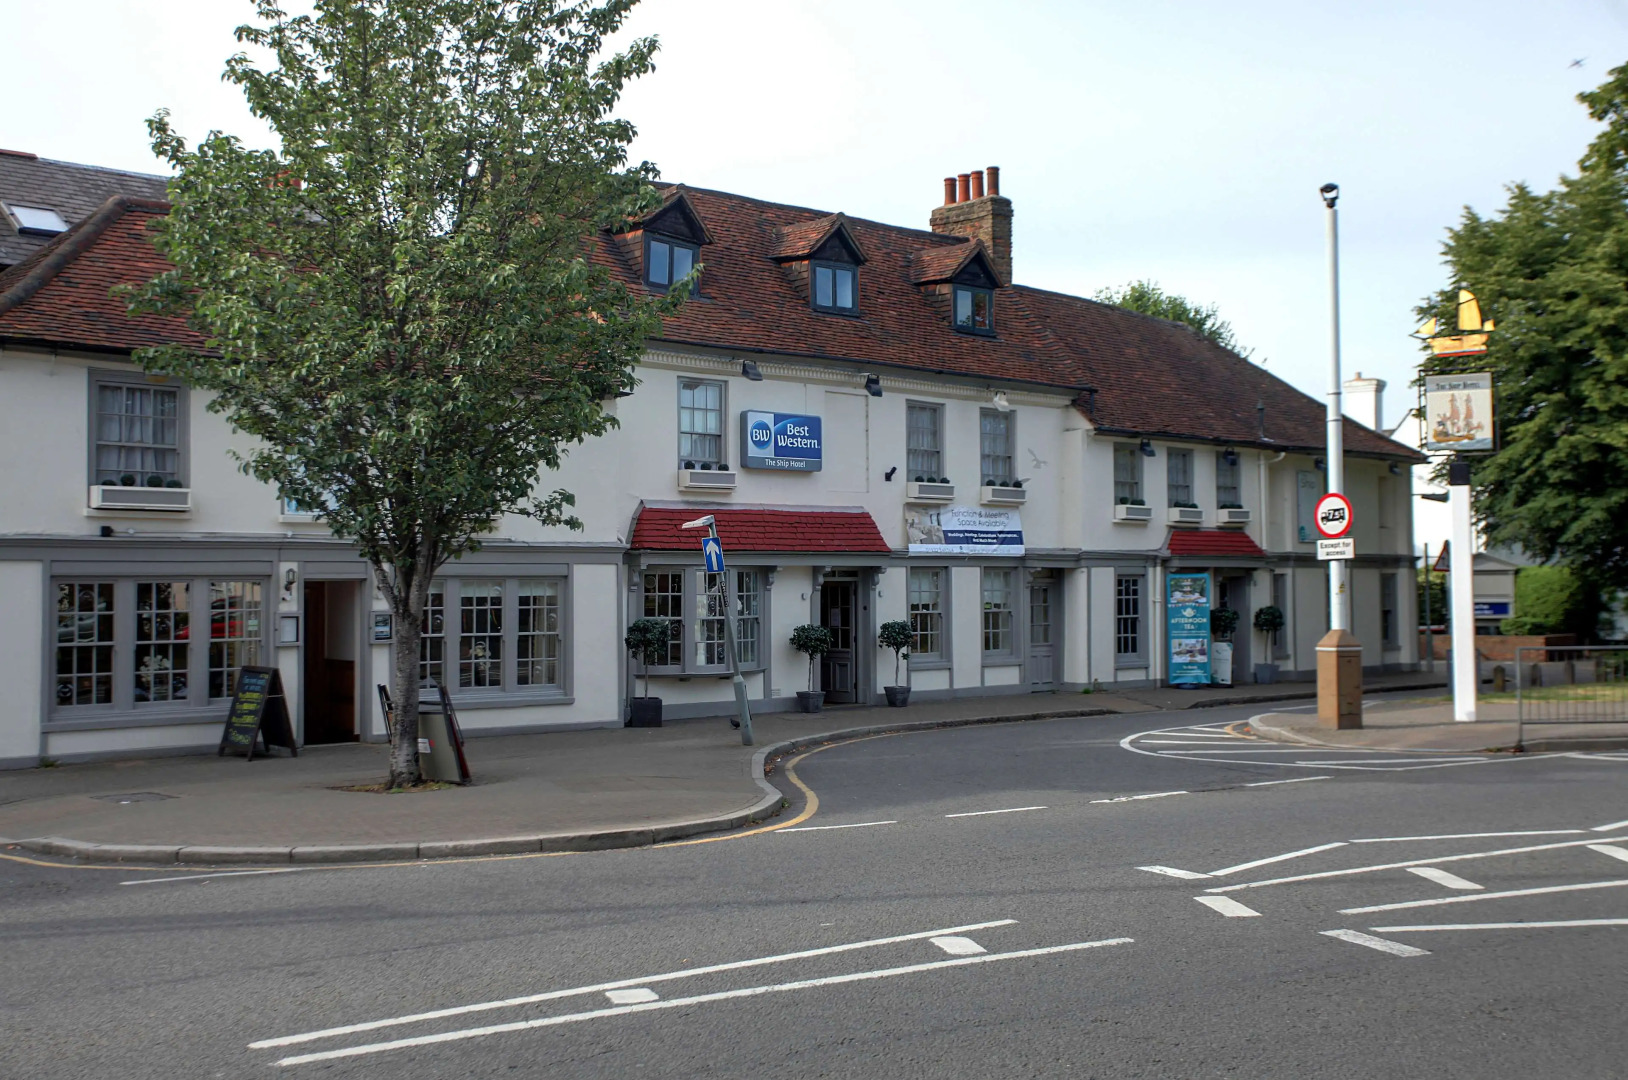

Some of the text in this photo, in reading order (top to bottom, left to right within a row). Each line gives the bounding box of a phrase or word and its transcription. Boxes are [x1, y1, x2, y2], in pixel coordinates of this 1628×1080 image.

[752, 428, 770, 442] BW
[787, 423, 810, 437] Best
[777, 434, 819, 449] Western
[765, 458, 806, 469] The Ship Hotel
[951, 509, 1010, 521] Function & Meeting
[957, 519, 1007, 528] Space Available
[1320, 542, 1341, 550] Except
